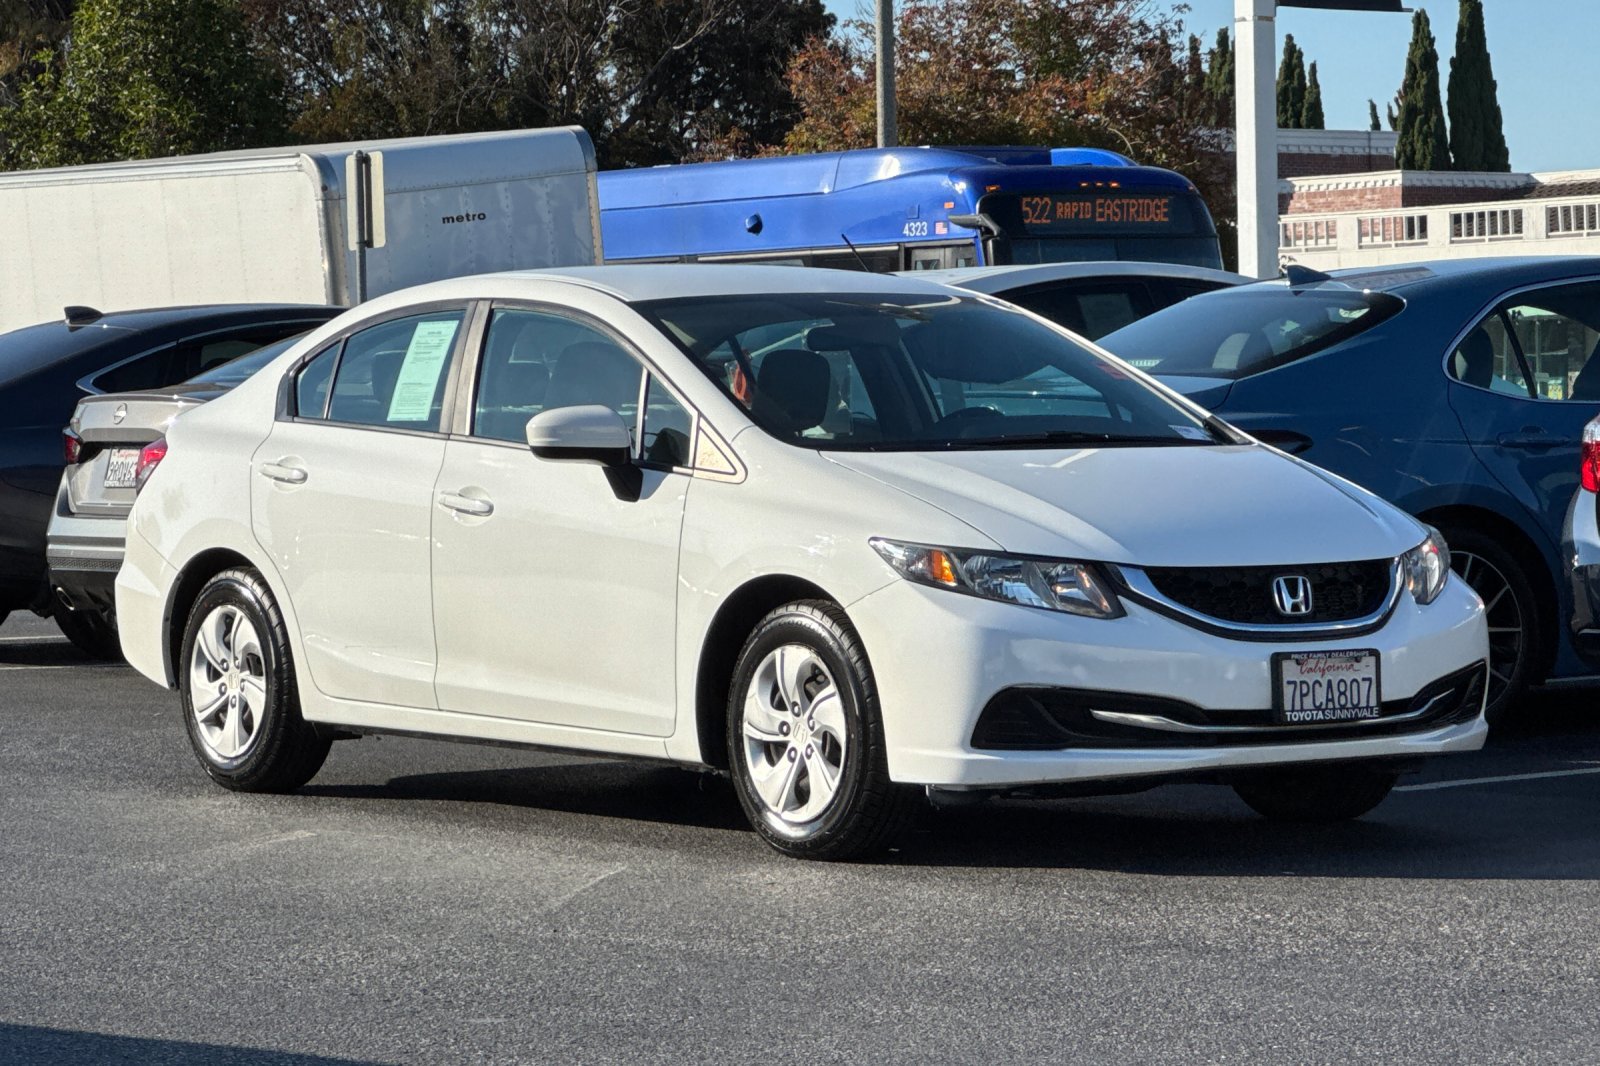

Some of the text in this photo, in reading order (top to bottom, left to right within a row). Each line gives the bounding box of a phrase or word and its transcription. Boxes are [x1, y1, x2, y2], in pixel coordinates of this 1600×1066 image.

[442, 212, 486, 224] metro
[1022, 197, 1169, 224] 522 RAPID EASTRIDGE
[903, 221, 928, 237] 4323
[1300, 660, 1360, 678] California
[1286, 677, 1373, 711] 7PCA807
[1285, 707, 1379, 722] TOYOTA SUNNYVALE
